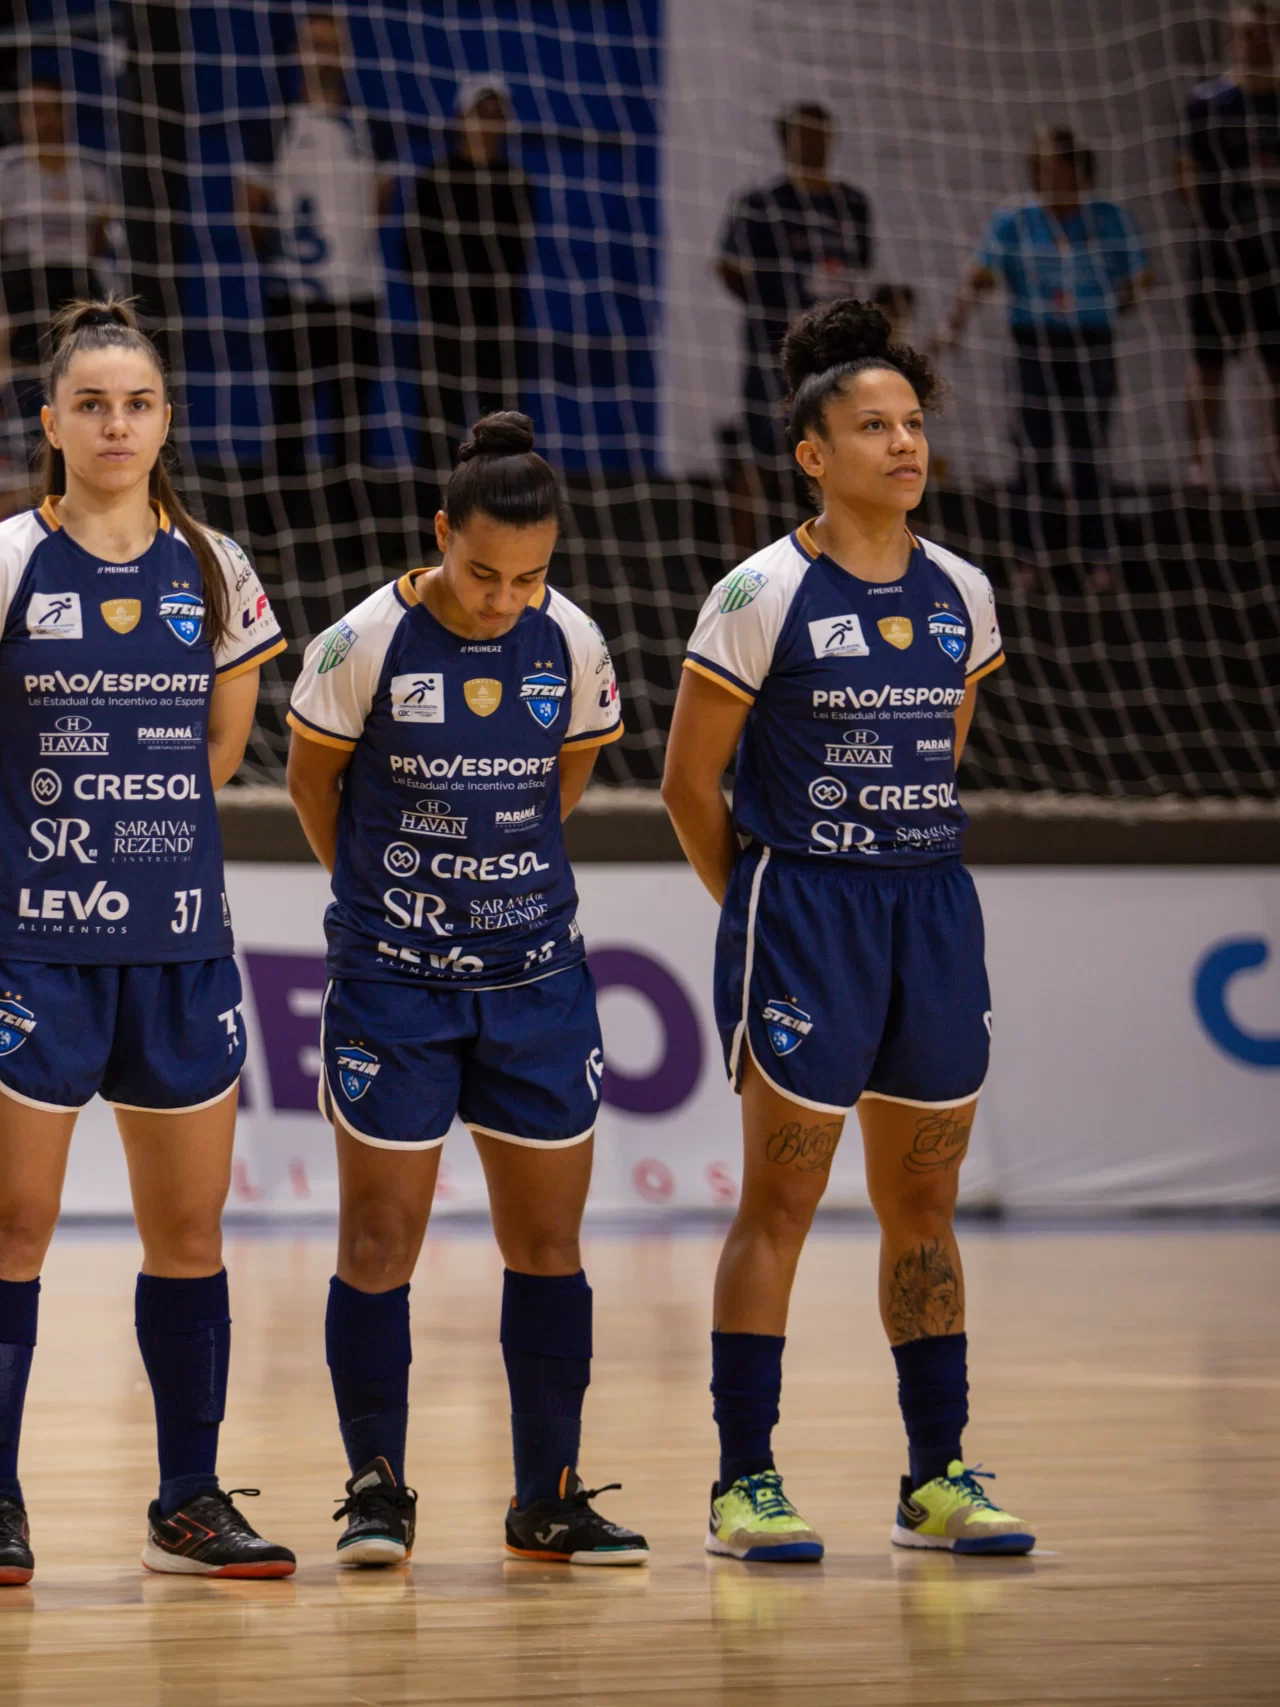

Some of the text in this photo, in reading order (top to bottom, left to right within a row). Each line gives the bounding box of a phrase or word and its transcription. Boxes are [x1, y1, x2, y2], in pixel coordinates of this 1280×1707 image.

[104, 566, 139, 574] MEINERZ
[873, 586, 903, 595] MEINERZ
[467, 645, 502, 653] MEINERZ
[519, 684, 567, 698] STEIN
[28, 696, 205, 708] Lei Estadual de Incentivo ao Esporte
[831, 711, 876, 720] Estadual
[878, 710, 891, 720] de
[893, 710, 933, 719] Incentivo
[137, 726, 193, 738] PARANÁ
[40, 736, 108, 752] HAVAN
[826, 747, 892, 764] HAVAN
[73, 774, 201, 801] CRESOL
[392, 775, 406, 785] Lei
[406, 777, 448, 790] Estadual
[450, 780, 465, 790] de
[467, 780, 515, 790] Incentivo
[859, 782, 957, 810] CRESOL
[495, 805, 536, 822] PARANÁ
[114, 820, 189, 837] SARAIVA
[401, 813, 467, 835] HAVAN
[431, 852, 549, 880] CRESOL
[19, 880, 130, 920] LEVO
[171, 888, 202, 934] 37
[470, 903, 548, 930] REZENDE
[17, 923, 128, 934] ALIMENTOS
[762, 1006, 814, 1036] STEIN
